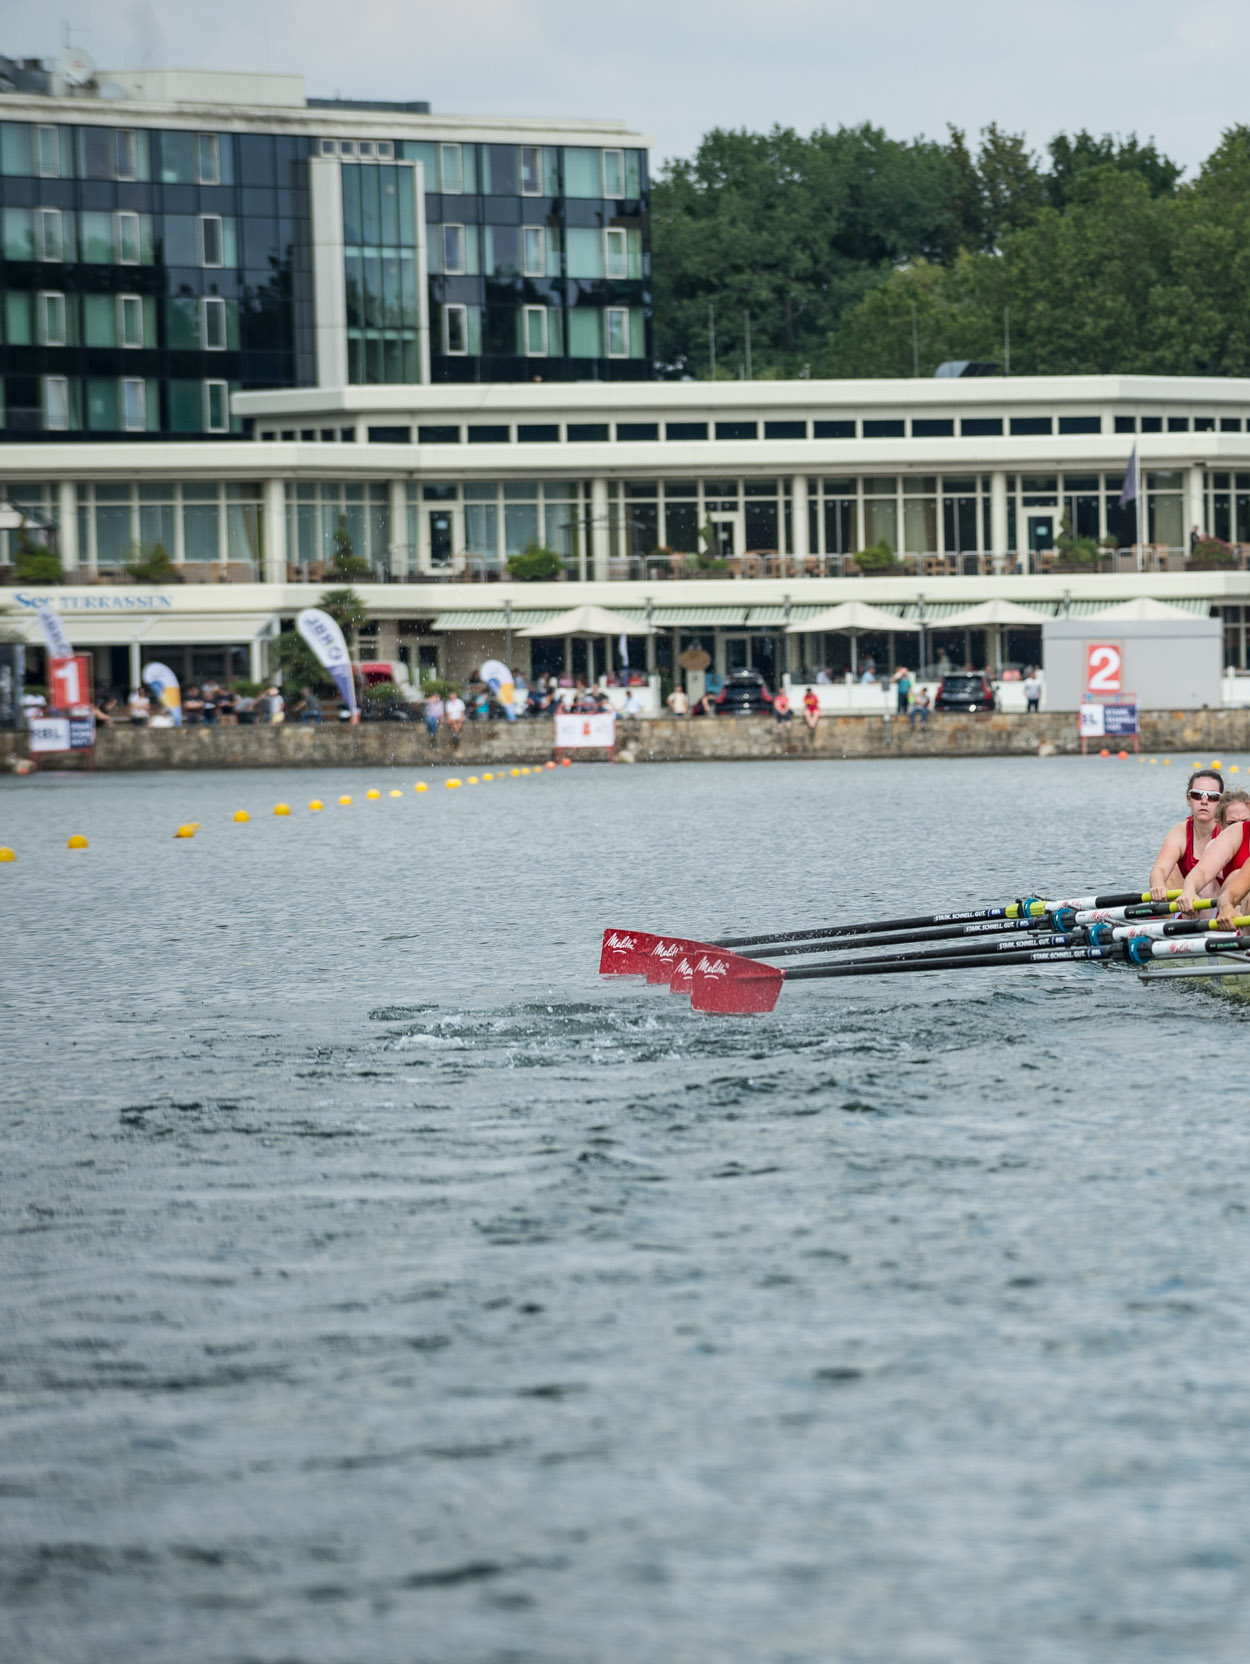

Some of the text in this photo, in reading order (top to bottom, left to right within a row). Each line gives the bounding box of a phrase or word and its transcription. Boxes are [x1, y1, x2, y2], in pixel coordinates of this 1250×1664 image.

[59, 595, 173, 609] TERRASSEN
[1089, 647, 1120, 690] 2
[55, 661, 80, 703] 1
[603, 933, 636, 951] Melitta
[693, 955, 728, 976] Melitta
